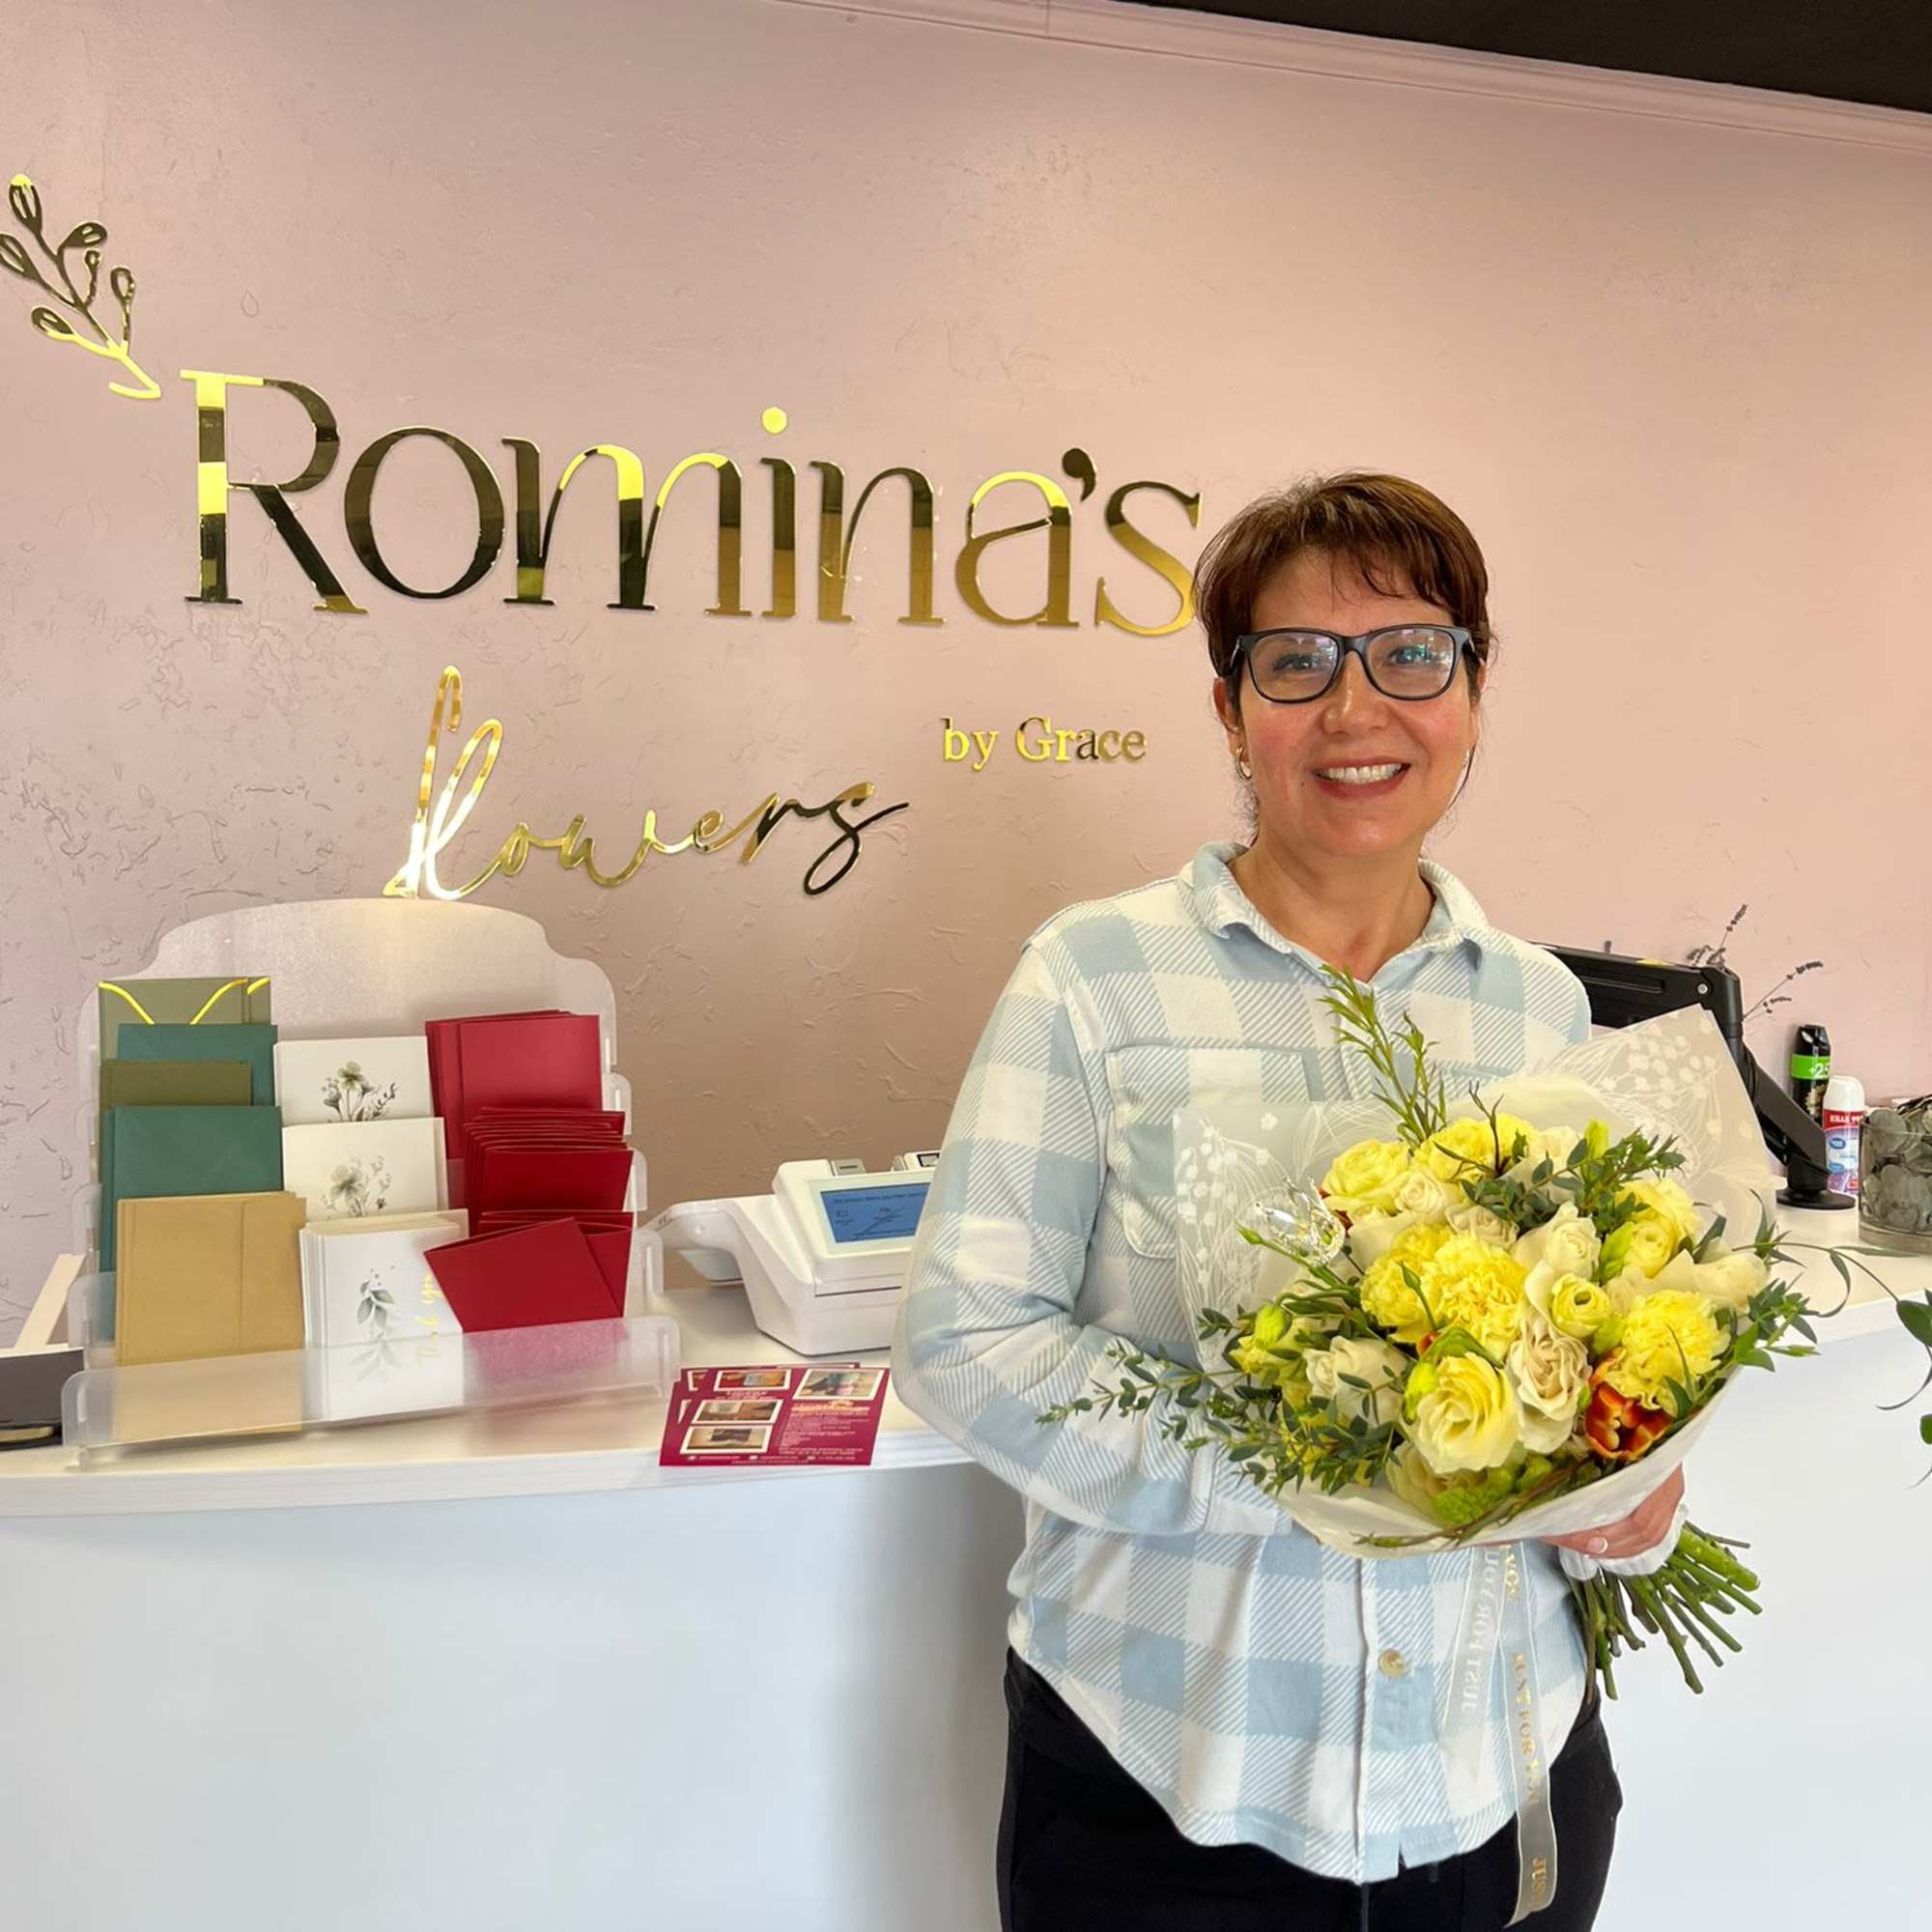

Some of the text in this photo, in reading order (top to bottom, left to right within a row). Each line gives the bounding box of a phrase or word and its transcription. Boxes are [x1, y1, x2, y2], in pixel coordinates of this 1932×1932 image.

[180, 369, 1201, 637] Romina's
[941, 715, 1147, 772] by Grace
